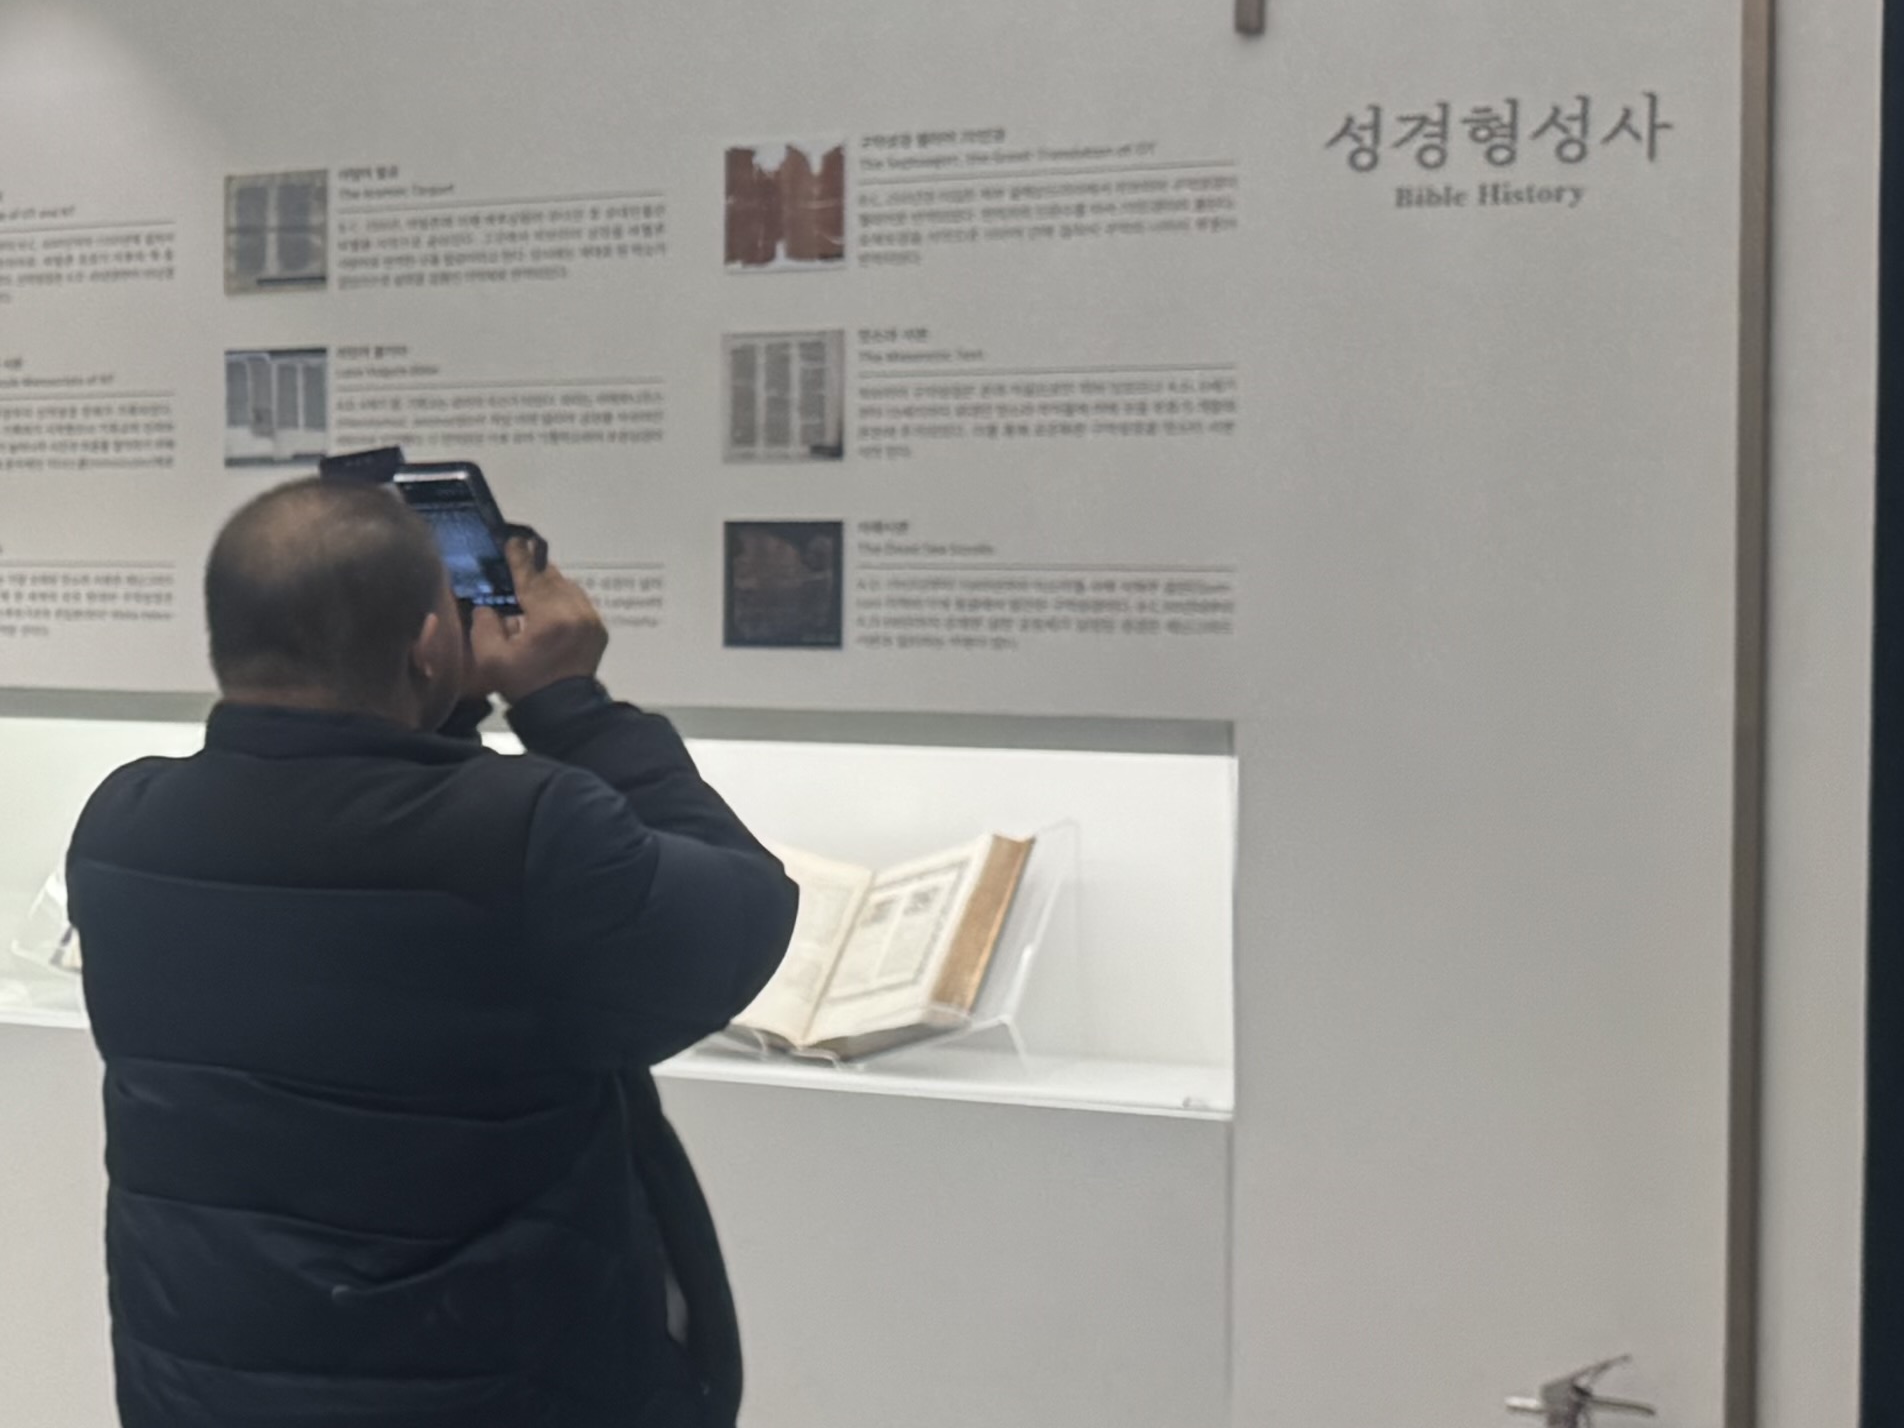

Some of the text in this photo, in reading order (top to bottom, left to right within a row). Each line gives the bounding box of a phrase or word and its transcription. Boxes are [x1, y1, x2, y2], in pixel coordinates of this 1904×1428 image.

[1324, 90, 1674, 173] 성경형성사
[1395, 183, 1585, 209] Bible History
